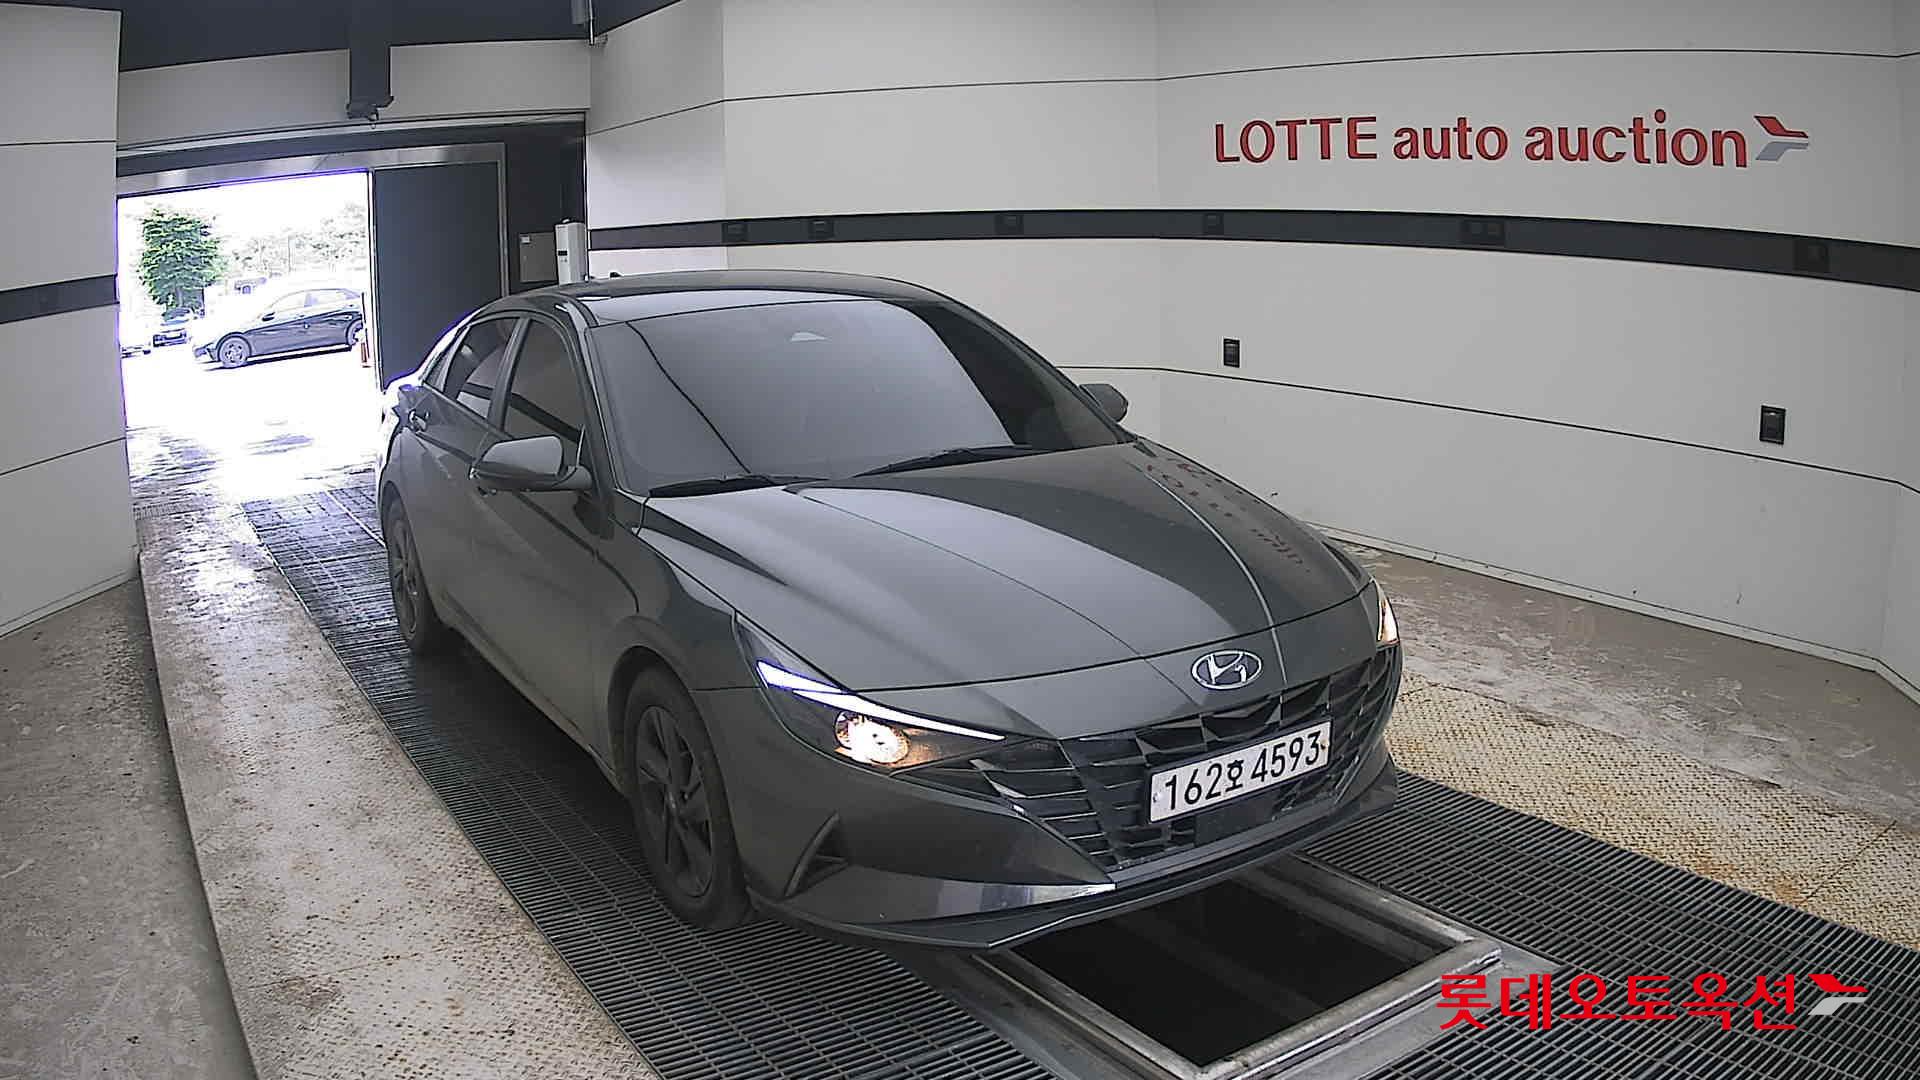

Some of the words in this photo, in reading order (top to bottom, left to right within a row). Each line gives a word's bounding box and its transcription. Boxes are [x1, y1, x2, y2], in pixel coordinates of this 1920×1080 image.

[1215, 116, 1378, 164] LOTTE
[1392, 116, 1509, 162] auto
[1523, 108, 1749, 169] auction
[1164, 758, 1244, 812] 162호
[1250, 730, 1323, 783] 4593
